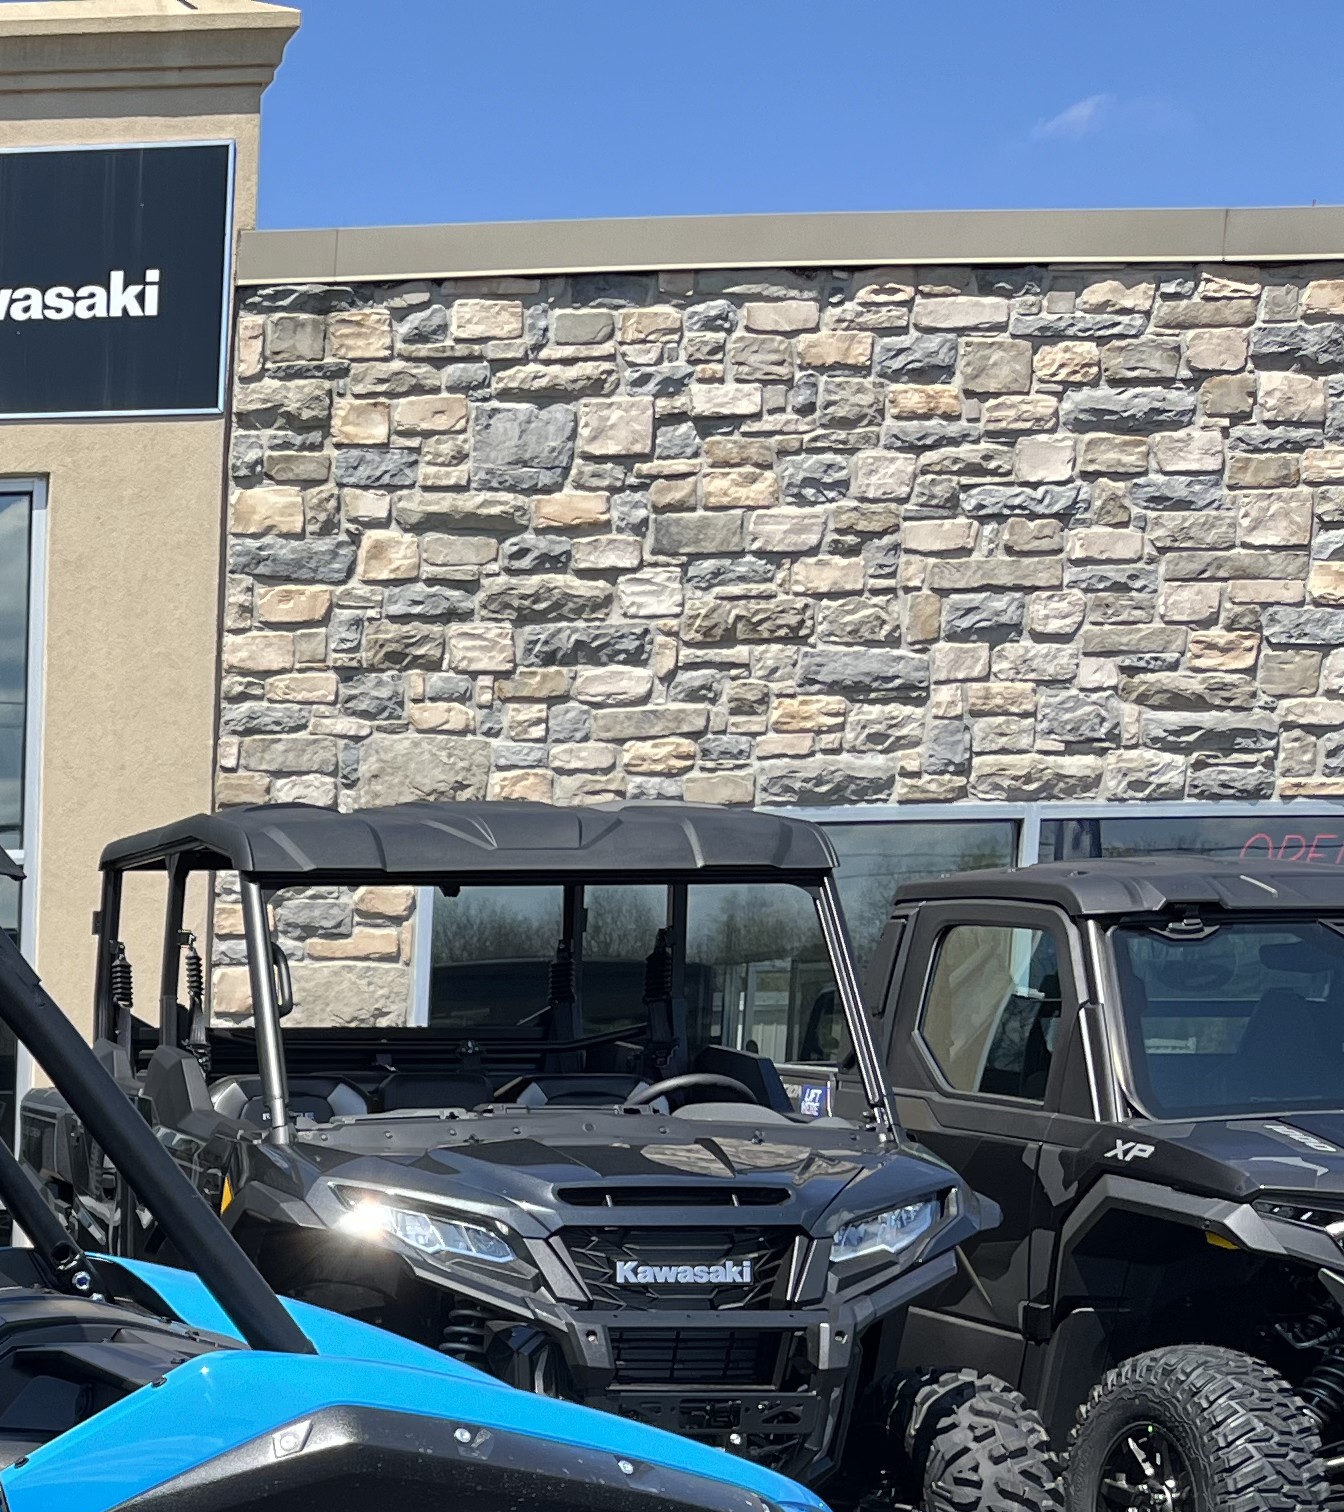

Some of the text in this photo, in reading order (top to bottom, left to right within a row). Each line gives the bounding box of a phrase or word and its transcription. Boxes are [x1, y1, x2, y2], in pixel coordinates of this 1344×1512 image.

[1239, 832, 1344, 865] OPE
[1104, 1139, 1155, 1161] XP
[616, 1261, 751, 1283] Kawasaki
